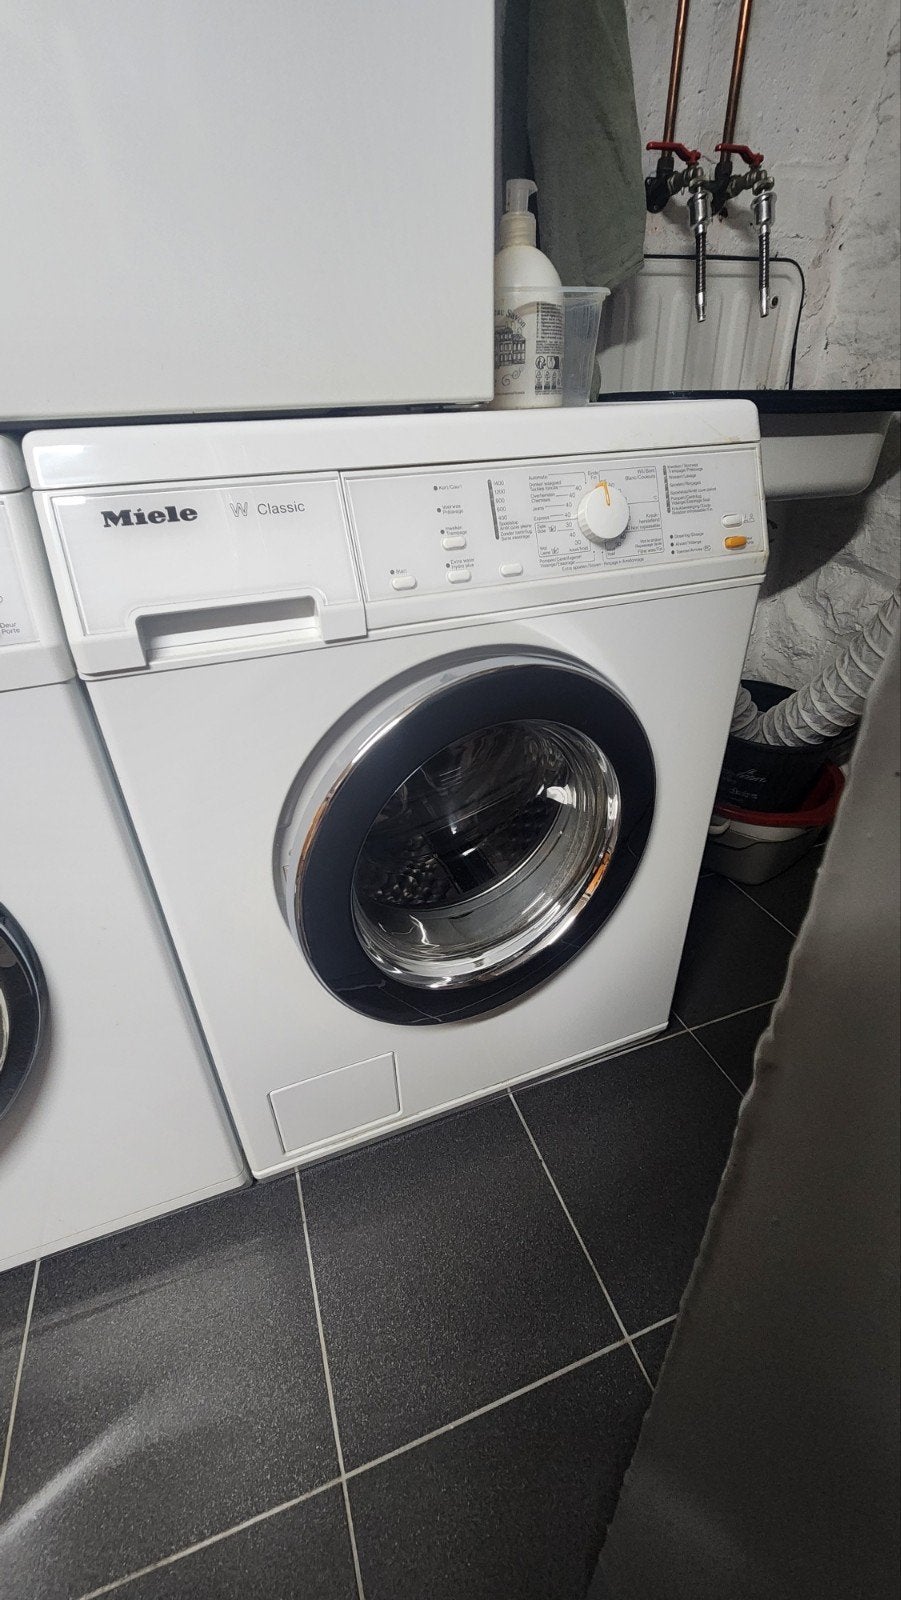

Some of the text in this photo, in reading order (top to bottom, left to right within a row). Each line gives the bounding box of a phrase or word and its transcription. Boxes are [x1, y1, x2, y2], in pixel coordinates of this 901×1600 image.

[506, 309, 527, 328] Savon
[101, 506, 198, 527] Miele
[229, 501, 305, 517] W Classic
